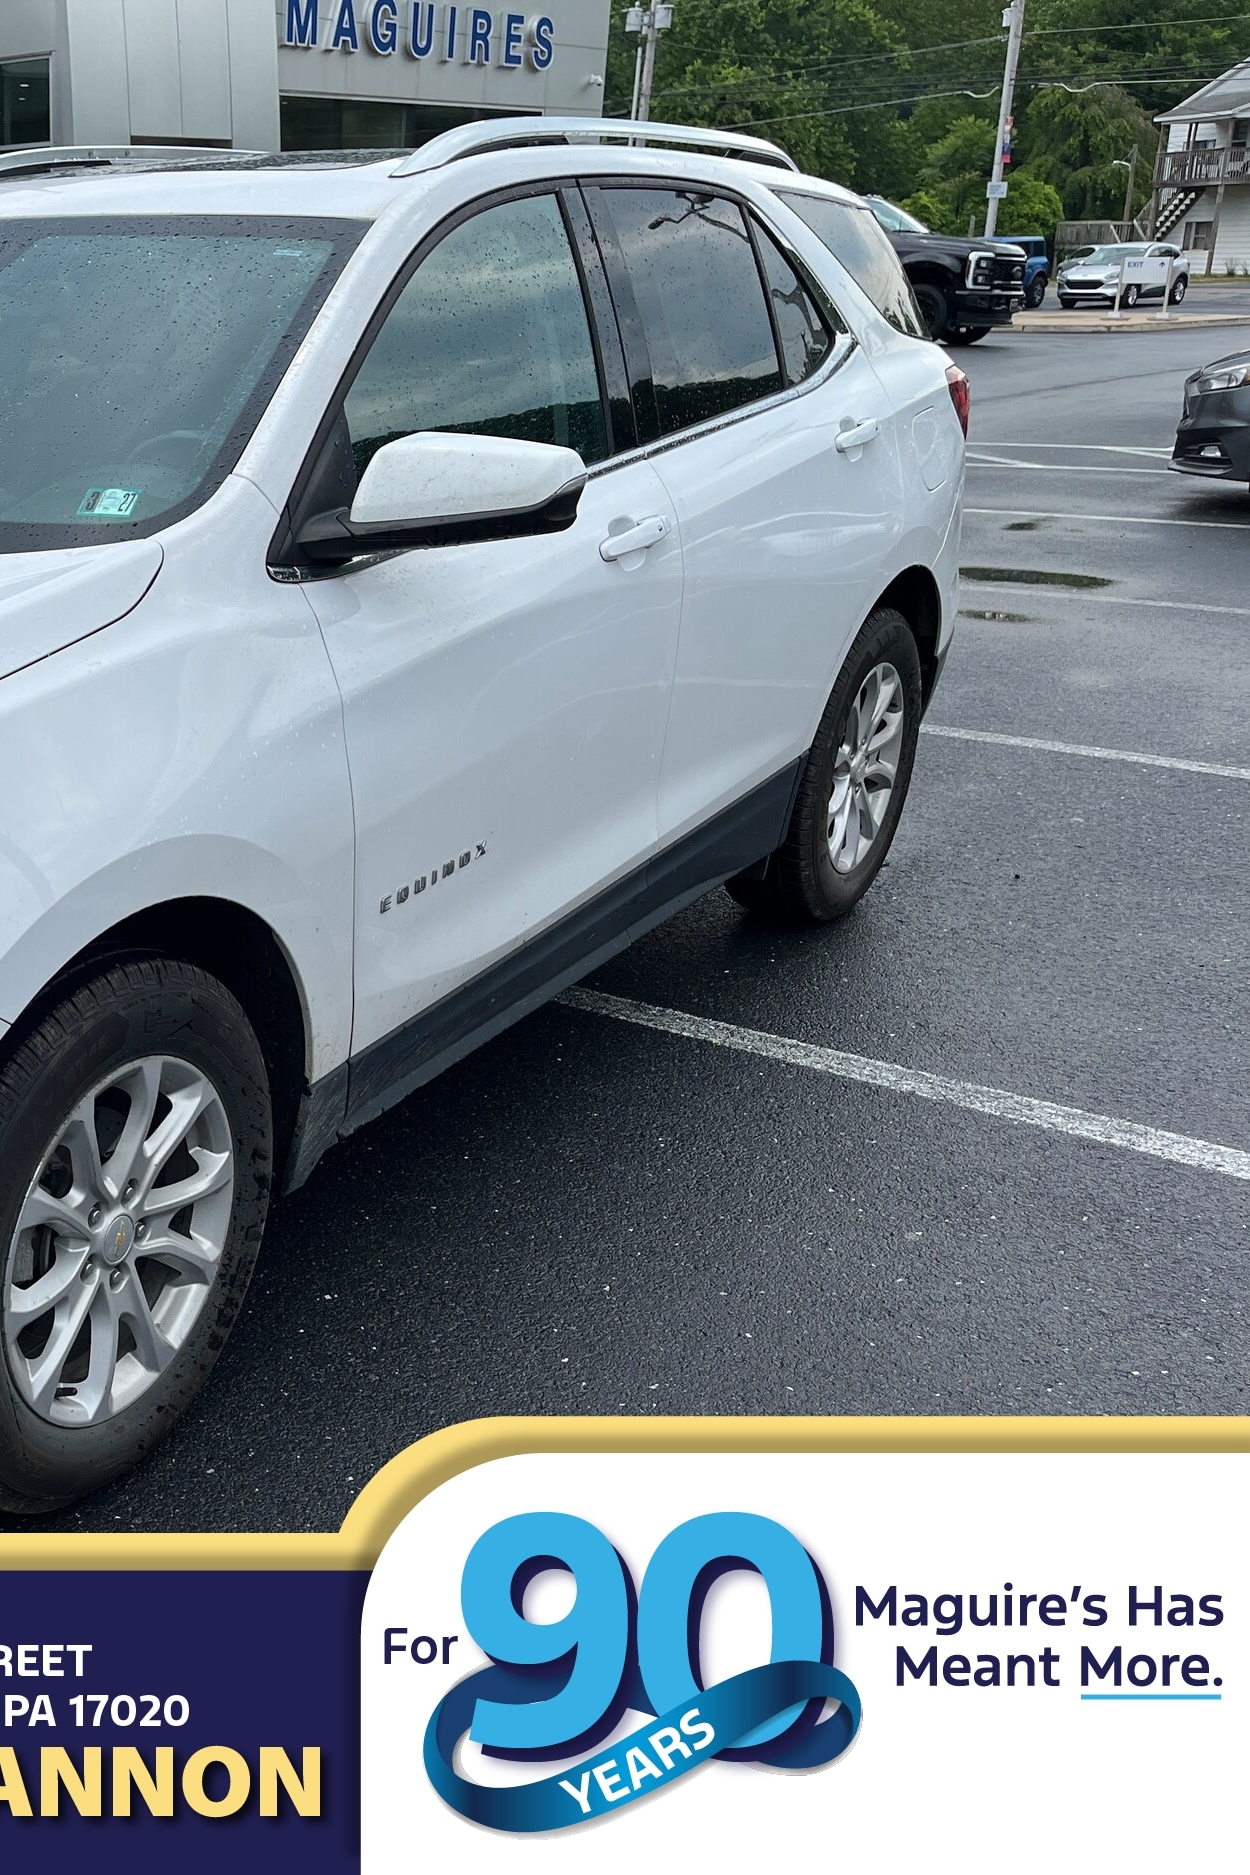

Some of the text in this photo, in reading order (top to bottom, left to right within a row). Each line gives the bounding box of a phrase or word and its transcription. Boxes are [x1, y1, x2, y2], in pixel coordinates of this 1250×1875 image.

[284, 0, 556, 72] MAGUIRES
[1127, 261, 1144, 269] EXIT
[85, 491, 137, 513] 3 27
[380, 839, 487, 914] EQUINOX
